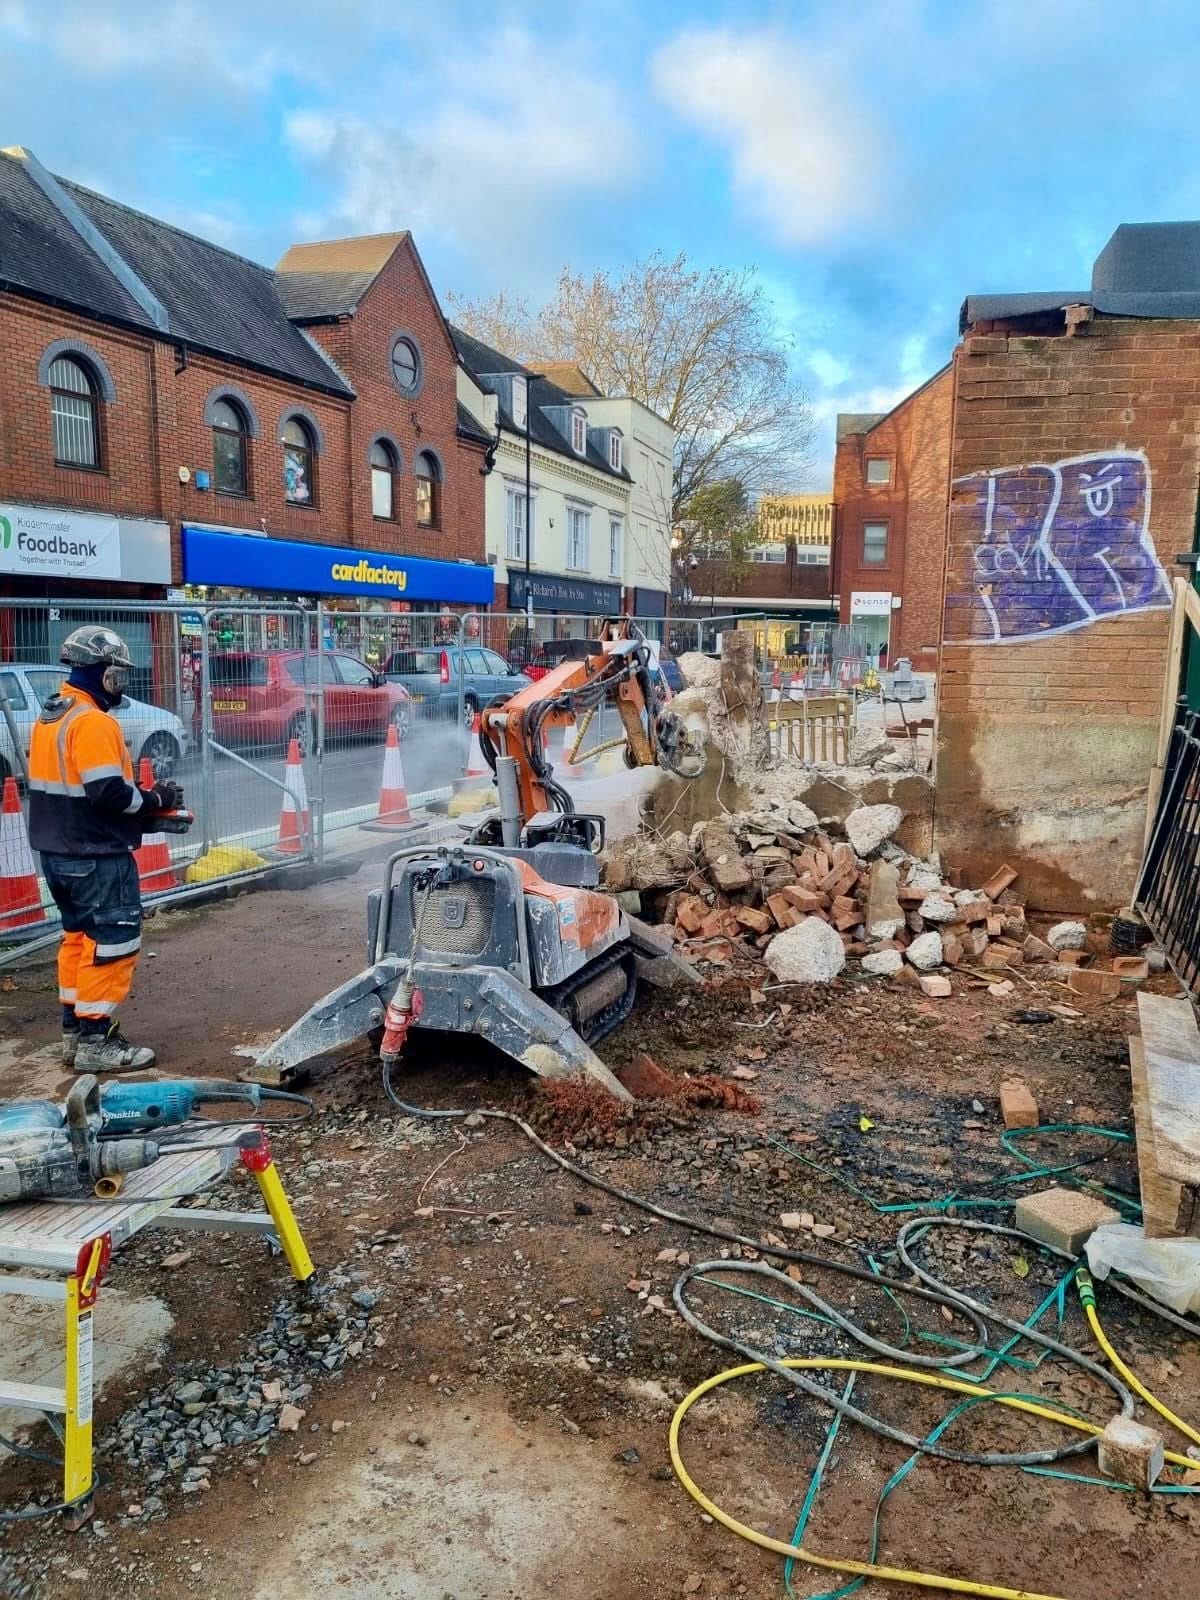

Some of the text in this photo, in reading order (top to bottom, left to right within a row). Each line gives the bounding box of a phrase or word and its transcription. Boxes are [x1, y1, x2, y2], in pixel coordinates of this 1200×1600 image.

[17, 517, 71, 532] Kidderminster
[17, 533, 97, 557] Foodbank
[19, 555, 87, 567] Together with Trussell
[331, 559, 407, 591] cardfactory
[49, 608, 61, 621] 82
